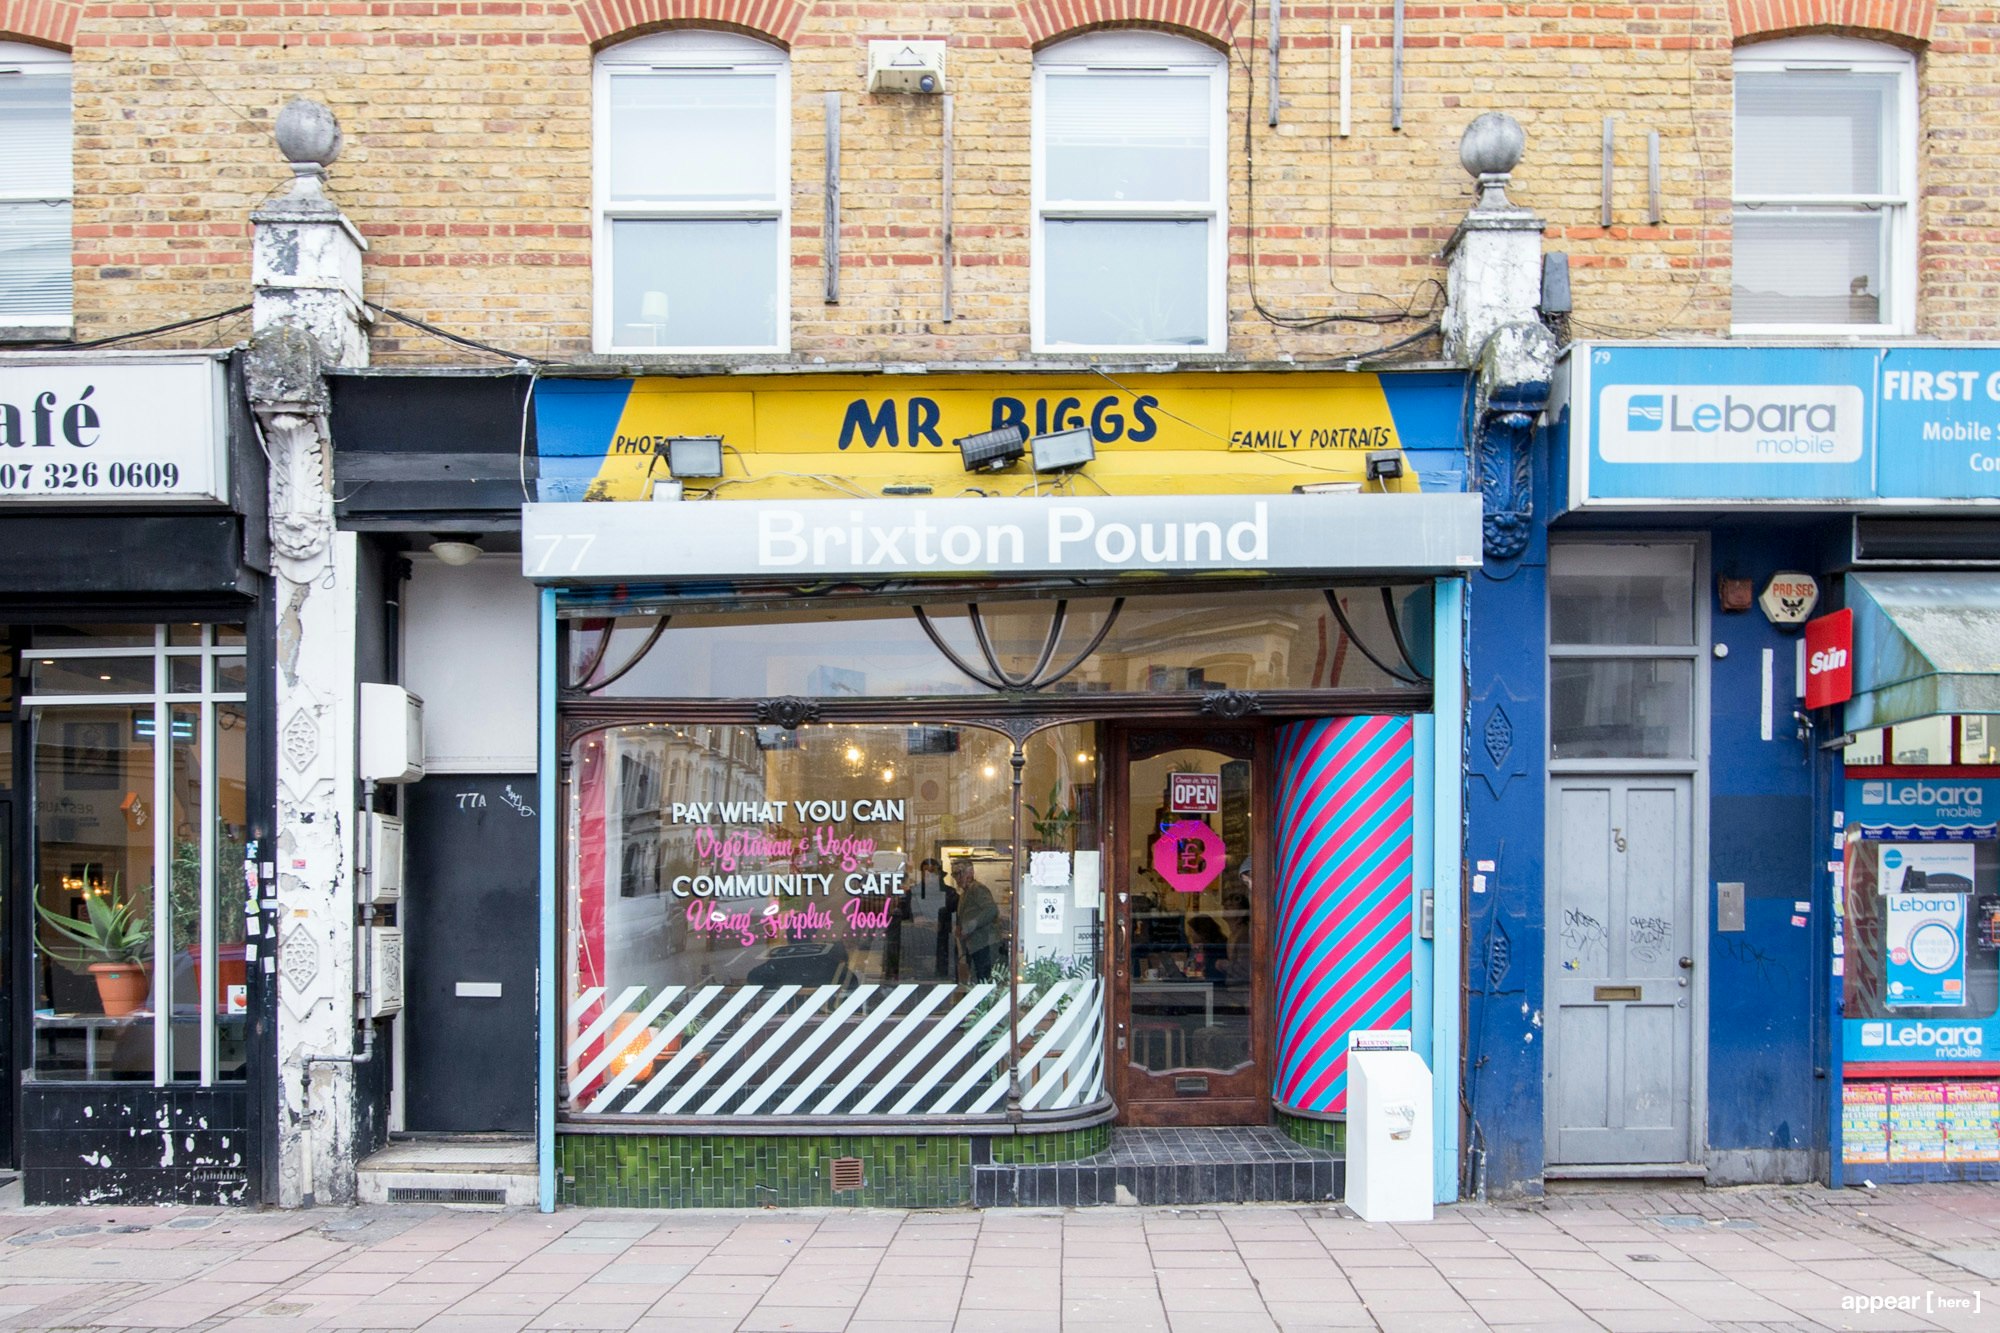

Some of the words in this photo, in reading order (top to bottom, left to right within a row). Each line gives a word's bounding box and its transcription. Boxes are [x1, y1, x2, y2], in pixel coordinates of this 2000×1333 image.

[1594, 351, 1611, 364] 79
[1883, 370, 1980, 401] FIRST
[991, 395, 1158, 443] BIGGS
[1671, 394, 1836, 433] Lebara
[1231, 428, 1302, 450] FAMILY
[1310, 426, 1392, 449] PORTRAITS
[1923, 421, 1992, 441] Mobile
[1756, 435, 1834, 454] mobile
[44, 462, 98, 488] 326
[109, 462, 179, 488] 0609
[758, 510, 1024, 567] Brixton
[1048, 501, 1269, 564] Pound
[533, 534, 596, 572] 77
[1772, 583, 1815, 597] PRO-SEC
[1810, 649, 1847, 675] Sun
[456, 793, 487, 809] 77A
[1175, 784, 1217, 804] OPEN
[1886, 782, 1982, 805] Lebara
[672, 802, 712, 824] PAY
[718, 801, 788, 823] WHAT
[794, 800, 846, 822] YOU
[852, 799, 904, 822] CAN
[1936, 806, 1982, 818] mobile
[695, 826, 794, 872] Vegetarian
[815, 825, 878, 873] Vegan
[1612, 828, 1627, 853] 79
[672, 873, 834, 897] COMMUNITY
[1891, 896, 1956, 912] Lebara
[686, 899, 753, 947] Using
[759, 900, 833, 940] Surplus
[842, 896, 893, 930] Food
[1886, 1022, 1982, 1046] Lebara
[1935, 1047, 1982, 1058] mobile
